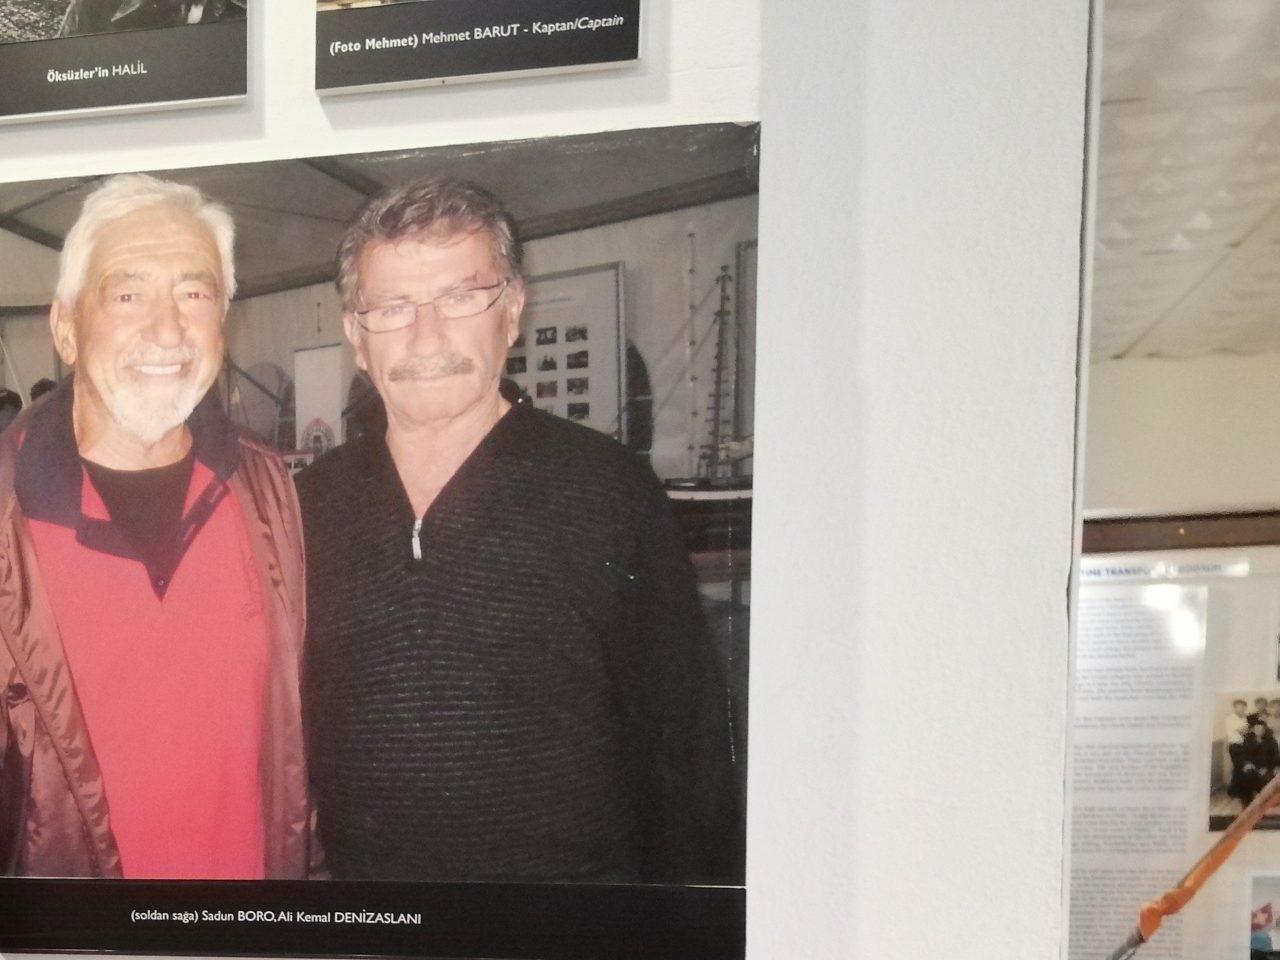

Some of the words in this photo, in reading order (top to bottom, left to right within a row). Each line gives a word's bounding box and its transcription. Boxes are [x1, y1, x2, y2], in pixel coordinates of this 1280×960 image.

[329, 40, 362, 56] (Foto
[364, 33, 419, 51] Mehmet)
[422, 30, 471, 45] Mehmet
[474, 23, 520, 40] BARUT
[532, 14, 624, 35] Kaptan/Captain
[112, 59, 148, 77] HALİL
[130, 909, 170, 923] (soldan
[172, 909, 199, 923] sağa)
[202, 909, 235, 922] Sadun
[297, 911, 331, 924] Kemal
[334, 908, 422, 925] DENİZASLANI
